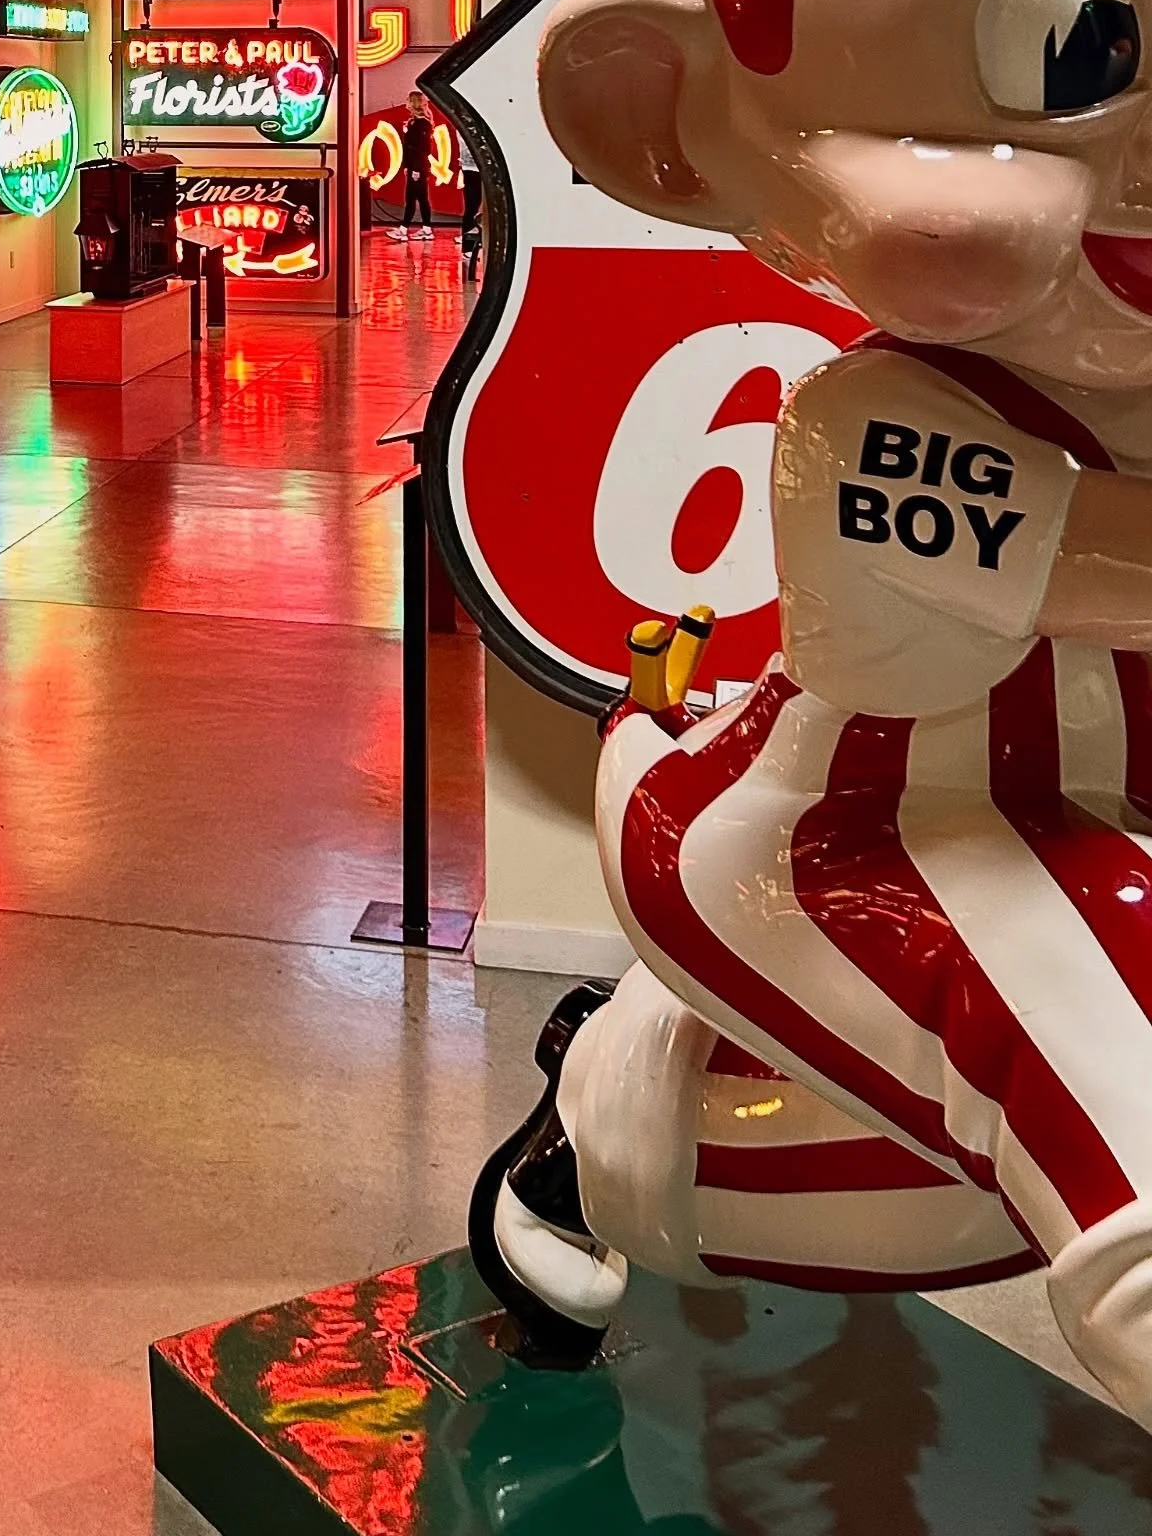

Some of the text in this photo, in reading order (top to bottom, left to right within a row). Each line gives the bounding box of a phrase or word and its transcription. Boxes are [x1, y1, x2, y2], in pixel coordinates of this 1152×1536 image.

[129, 38, 320, 67] PETER & PAUL
[130, 70, 282, 116] Florists
[859, 419, 1016, 499] BIG
[839, 480, 1027, 571] BOY
